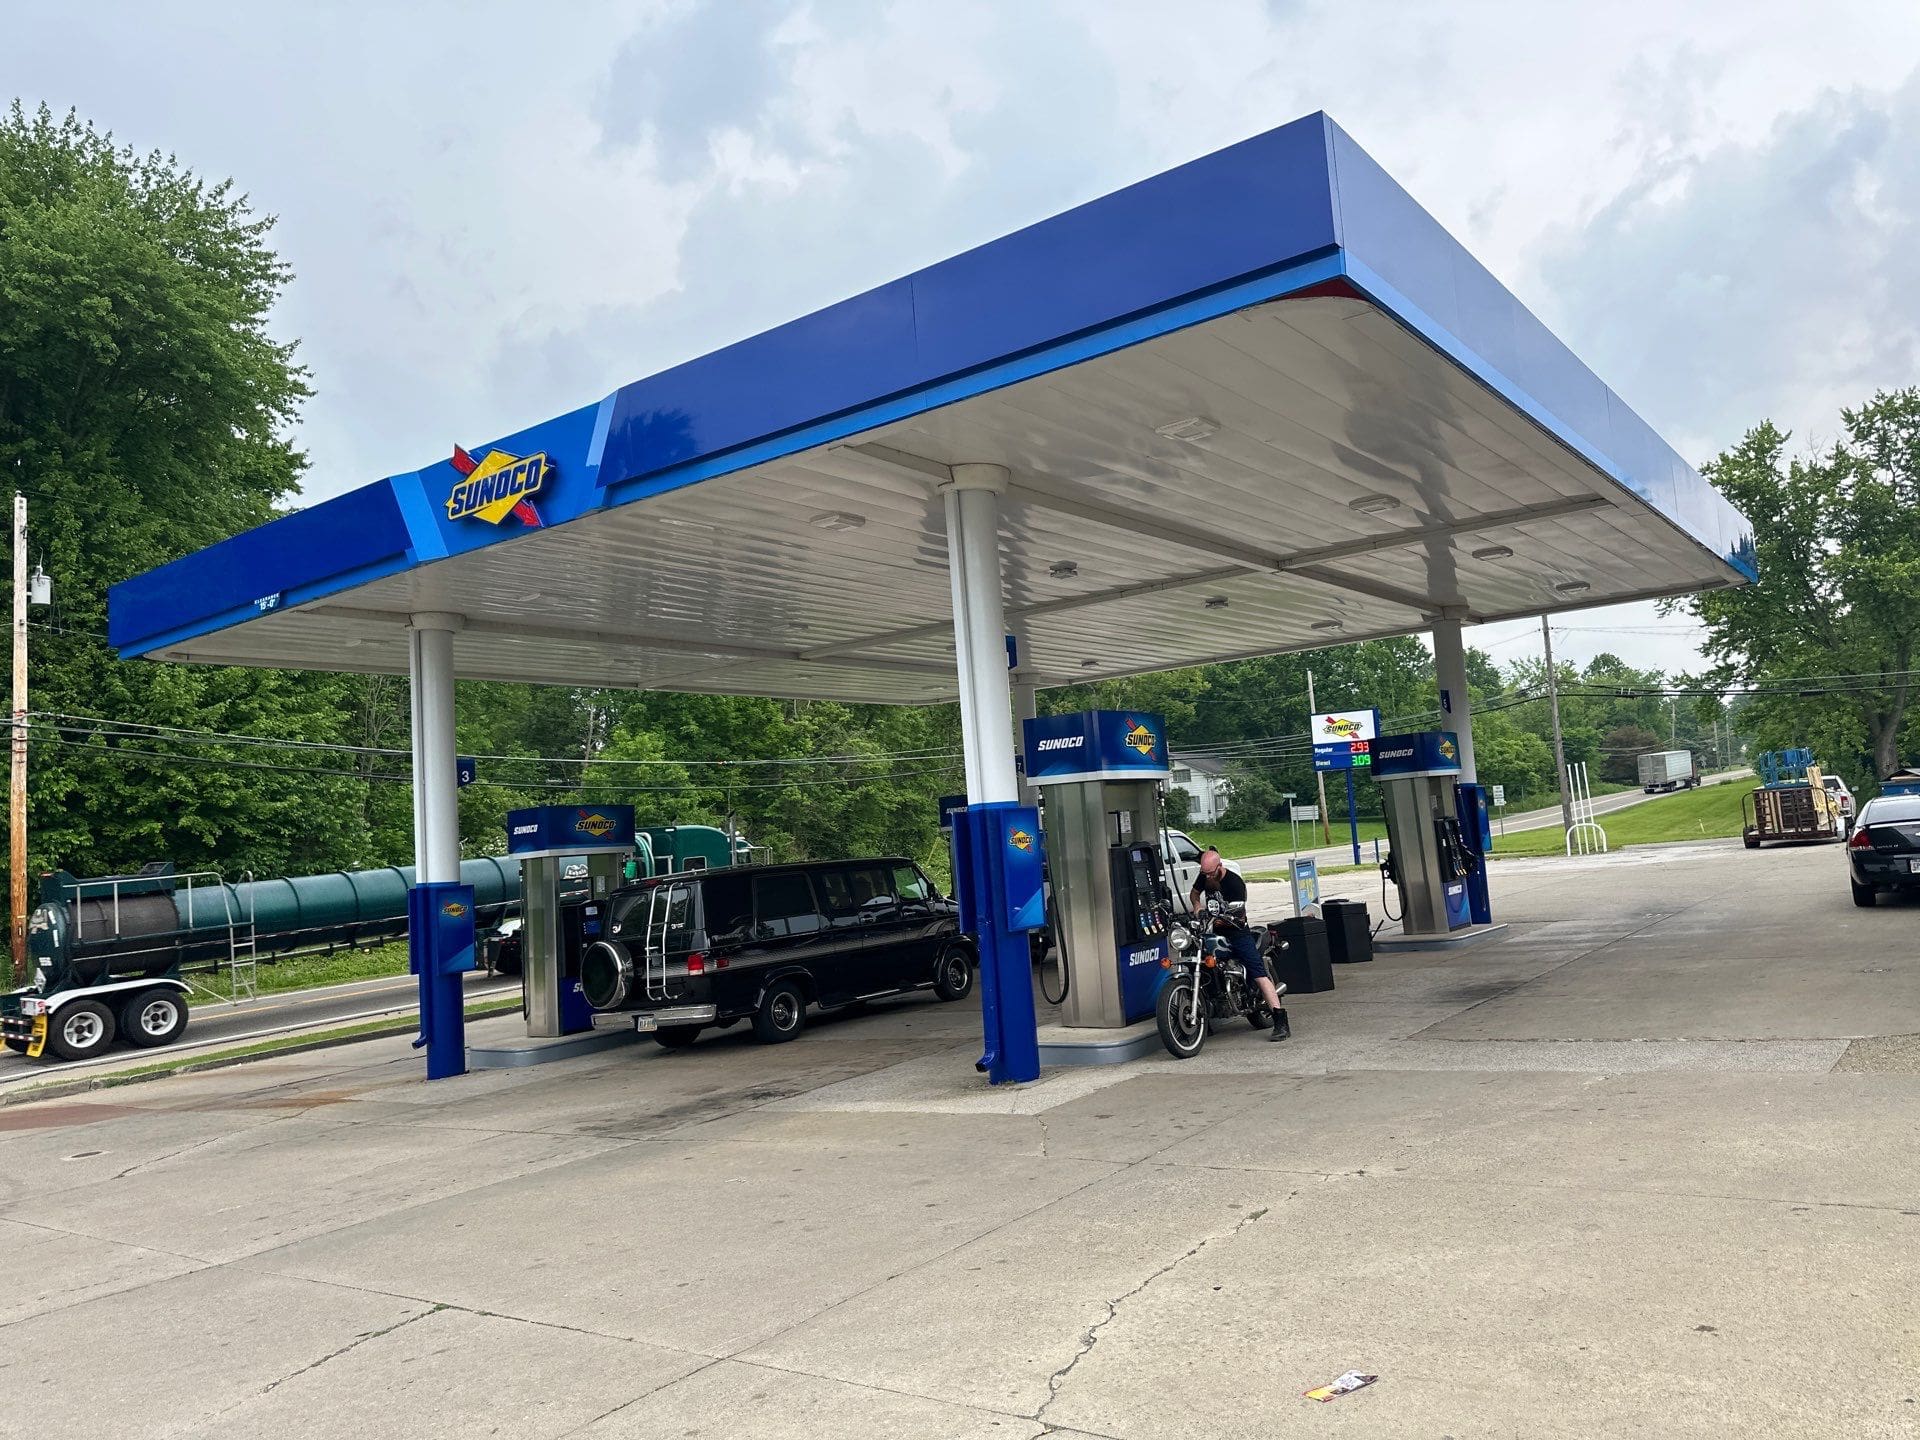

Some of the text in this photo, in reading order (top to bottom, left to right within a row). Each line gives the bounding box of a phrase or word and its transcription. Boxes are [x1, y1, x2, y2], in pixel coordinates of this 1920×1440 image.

[451, 459, 541, 516] SUNOCO
[1327, 723, 1360, 733] SUNOCO
[1038, 736, 1084, 751] SUNOCO
[1127, 734, 1155, 746] SUNOCO
[1379, 748, 1414, 759] SUNOCO
[461, 770, 470, 782] 3
[513, 824, 539, 835] SUNOCO
[577, 820, 615, 831] SUNOCO
[1010, 836, 1033, 845] SUNOCO
[1129, 947, 1160, 967] SUNOCO
